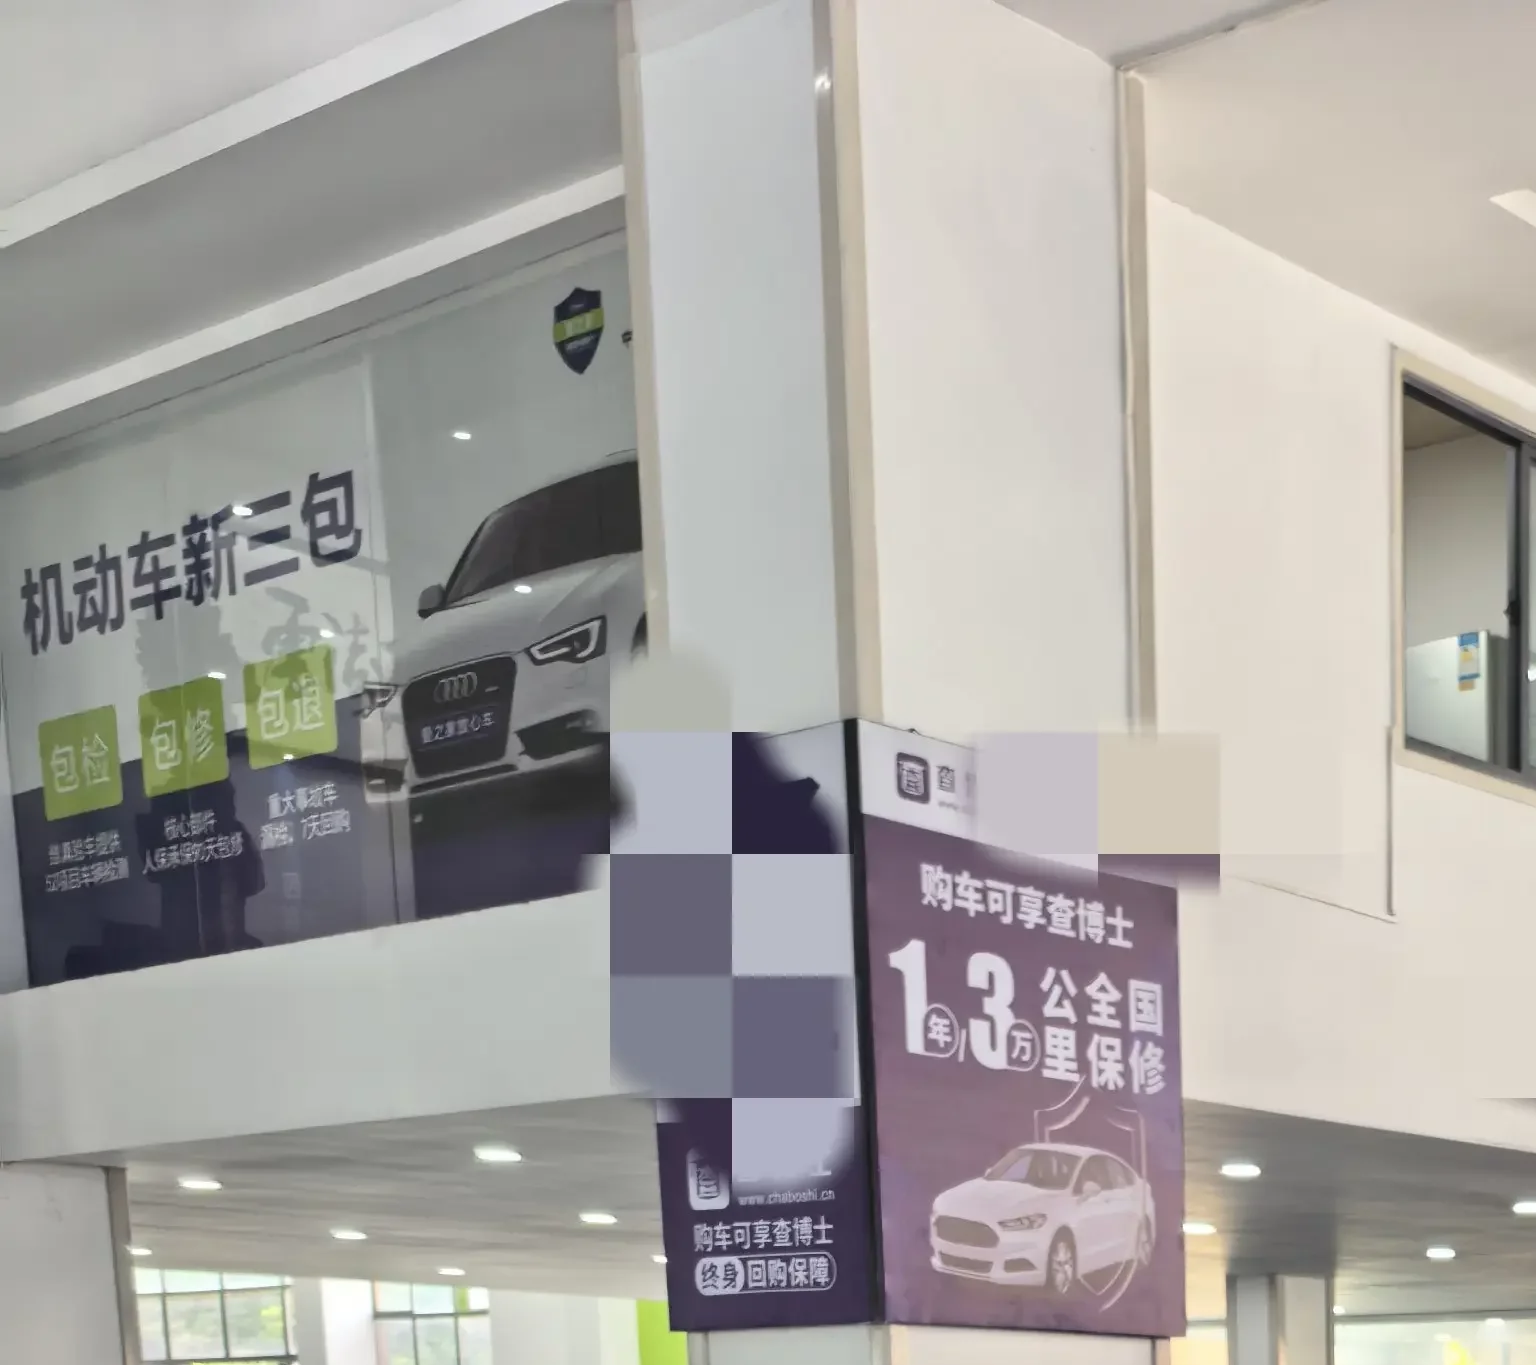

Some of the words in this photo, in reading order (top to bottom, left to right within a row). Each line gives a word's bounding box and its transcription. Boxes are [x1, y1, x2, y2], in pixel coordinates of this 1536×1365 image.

[21, 470, 362, 655] 机动车新三包
[151, 707, 214, 771] 包修
[920, 862, 1135, 949] 购车可享查博士
[693, 1214, 834, 1252] 购车可享查博士
